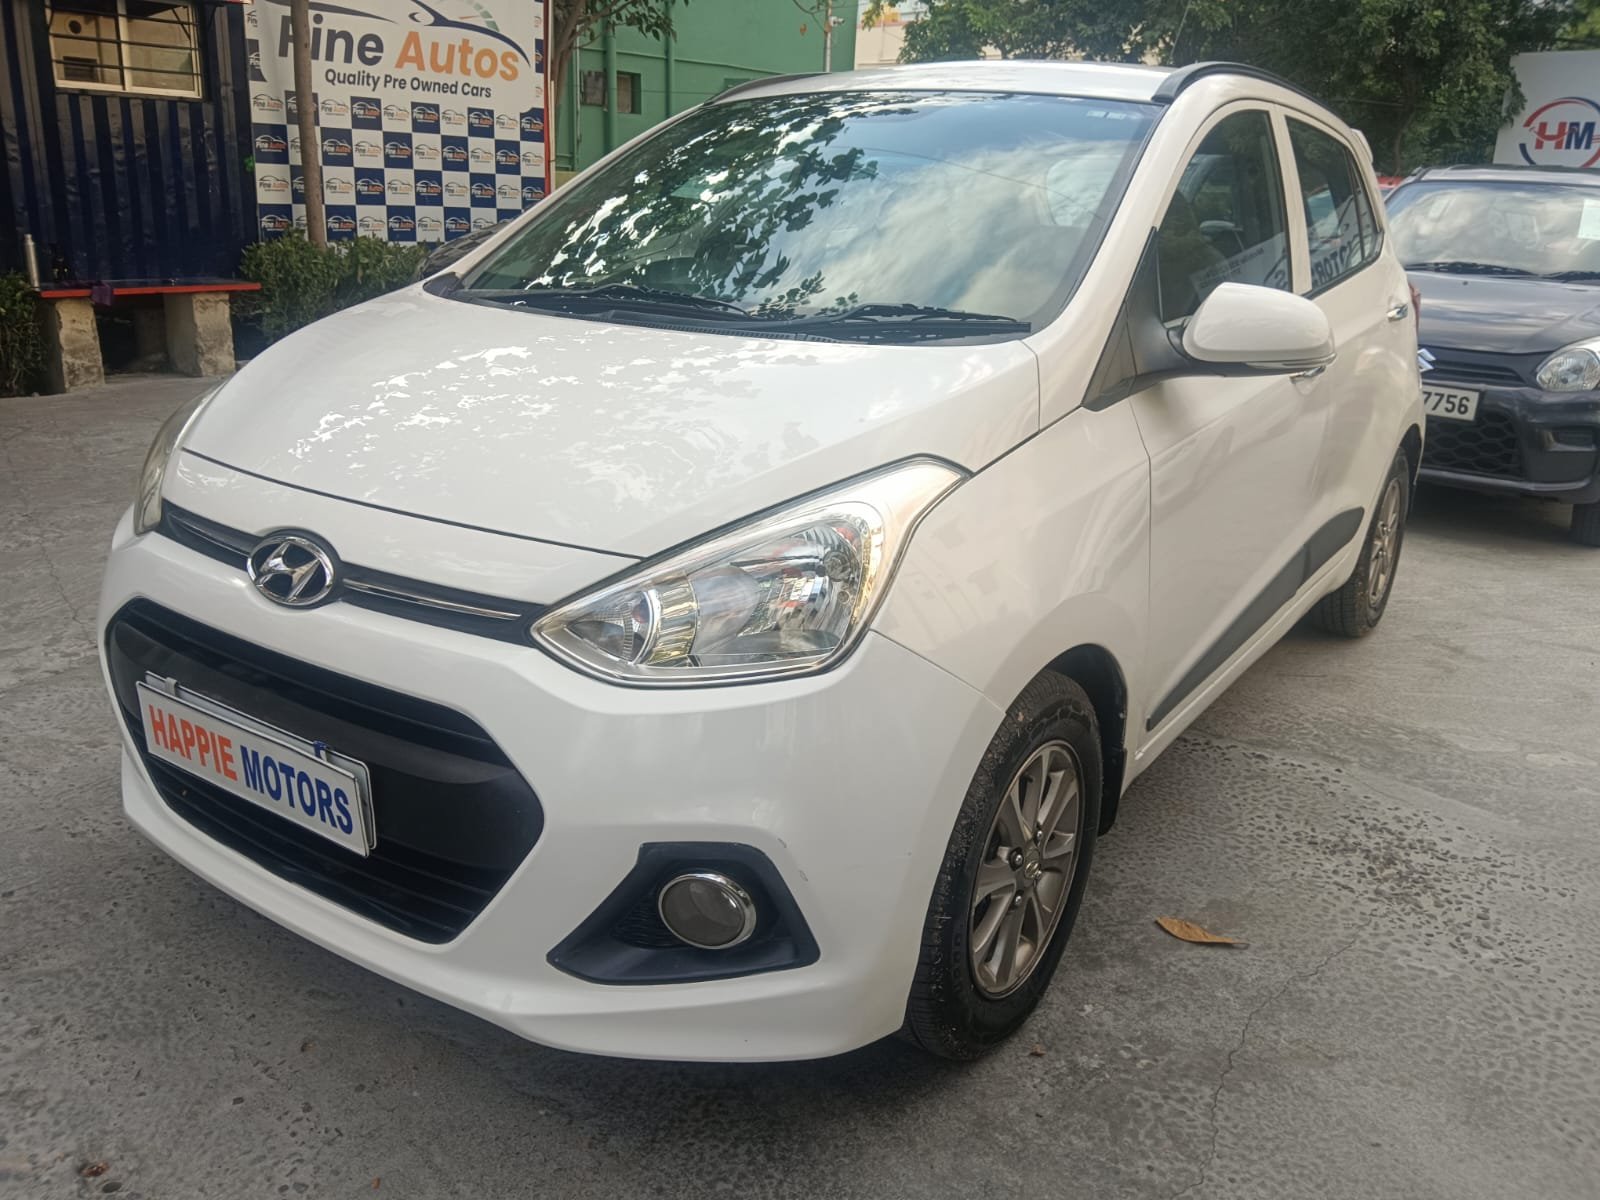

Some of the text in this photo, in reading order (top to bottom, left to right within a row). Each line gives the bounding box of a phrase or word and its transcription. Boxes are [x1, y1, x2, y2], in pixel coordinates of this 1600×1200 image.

[395, 30, 519, 81] Autos
[325, 68, 492, 98] Quality Pre Owned Cars
[1535, 121, 1596, 150] HM
[1422, 391, 1470, 415] 7756
[149, 704, 353, 836] HAPPIE MOTORS
